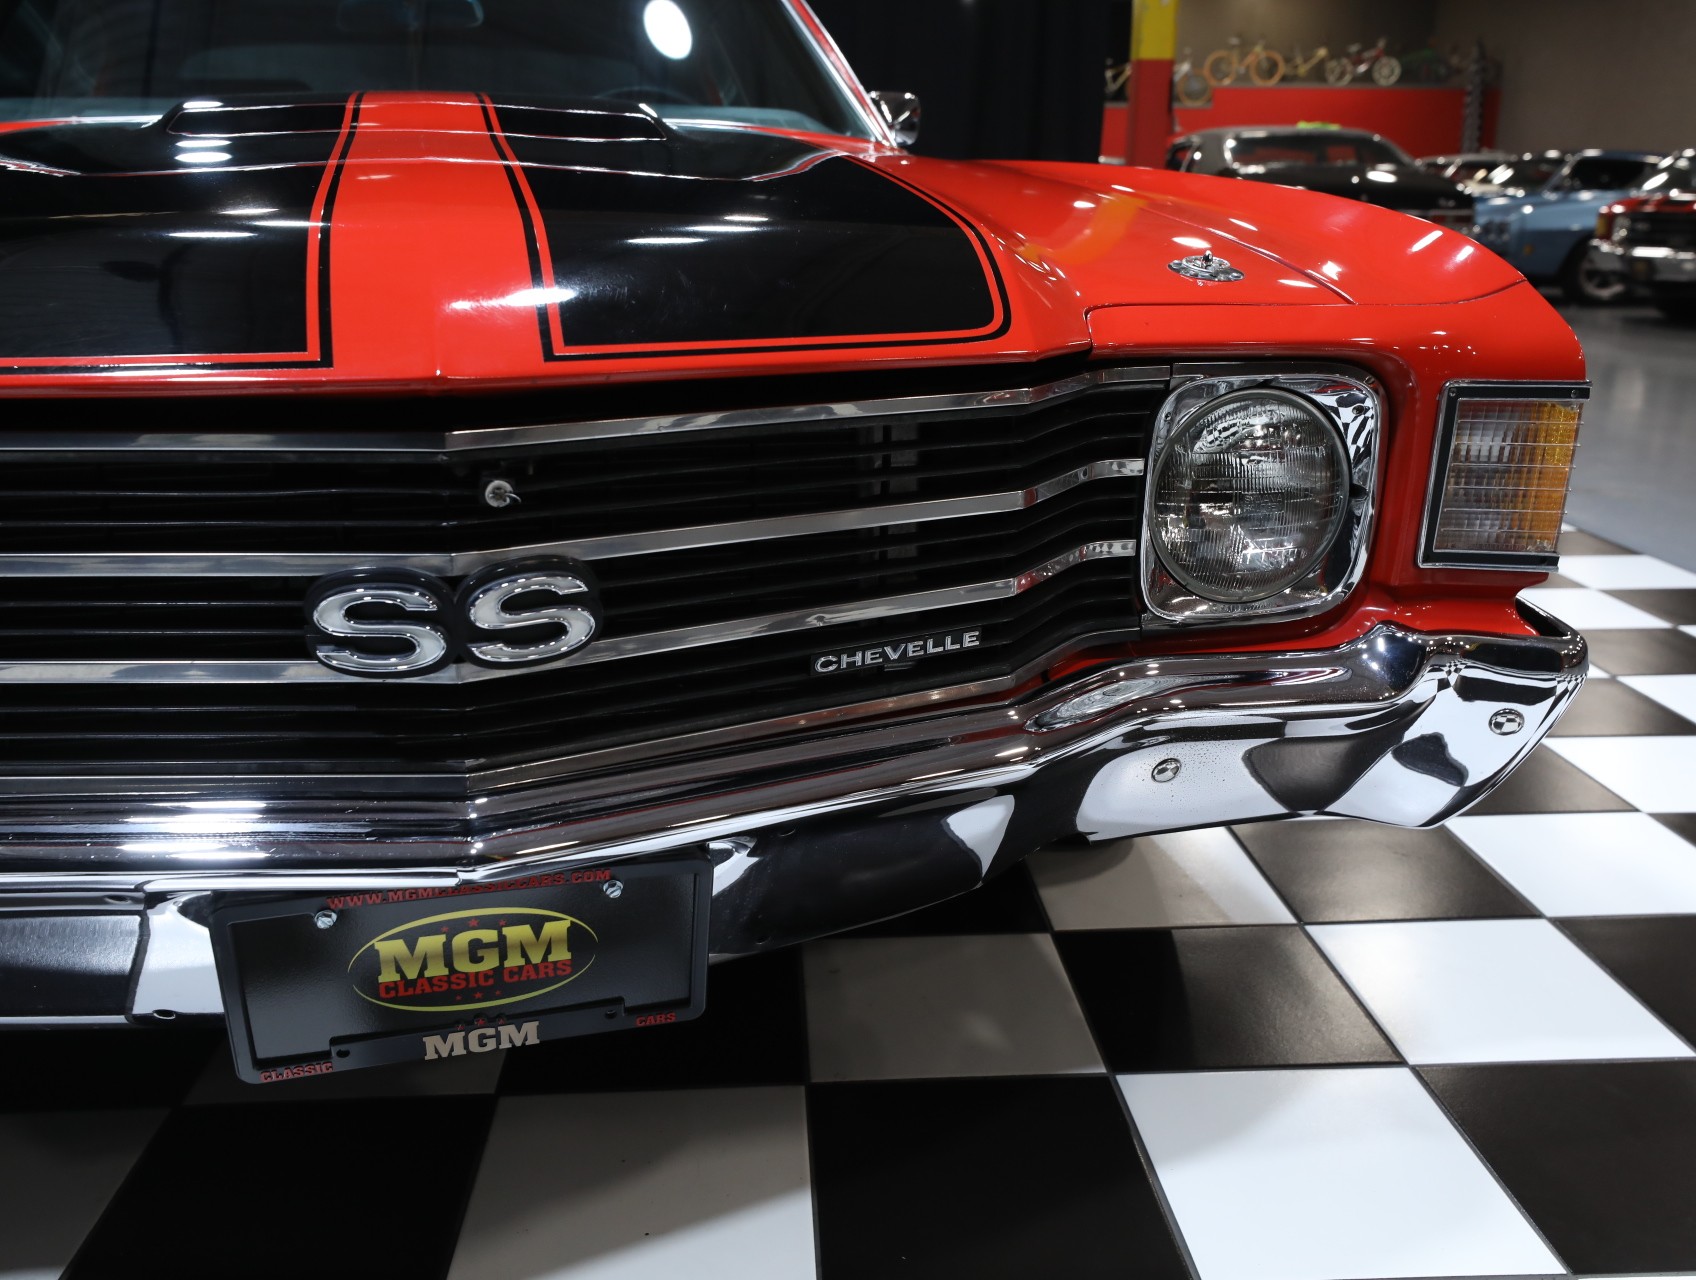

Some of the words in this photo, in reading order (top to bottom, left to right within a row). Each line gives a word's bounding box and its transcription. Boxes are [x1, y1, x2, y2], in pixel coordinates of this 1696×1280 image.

[312, 574, 597, 672] SS
[814, 631, 980, 673] CHEVELLE
[374, 919, 572, 983] MGM
[378, 969, 495, 999] CLASSIC
[503, 959, 573, 984] CARS
[259, 1061, 333, 1083] CLASSIC
[422, 1020, 541, 1061] MGM
[635, 1011, 677, 1027] CARS
